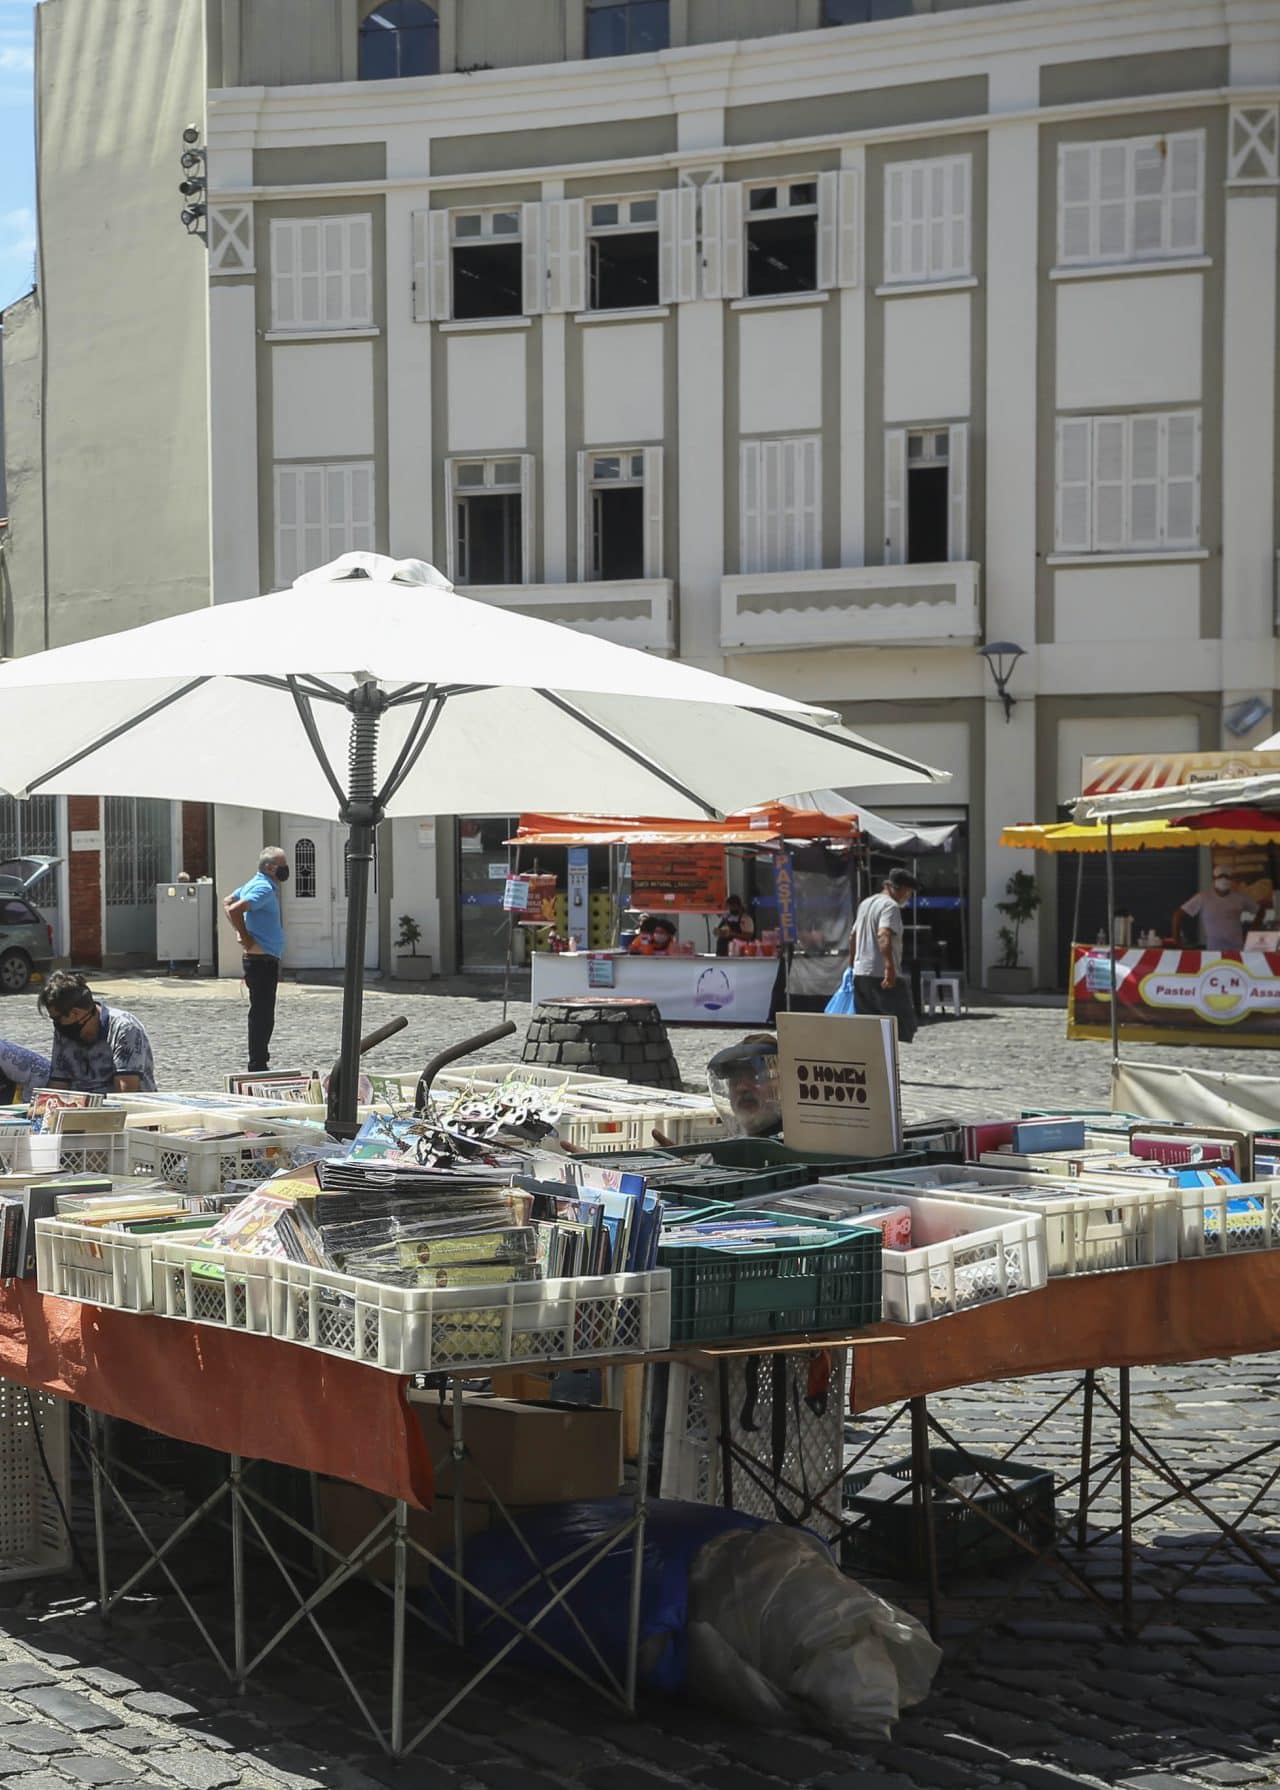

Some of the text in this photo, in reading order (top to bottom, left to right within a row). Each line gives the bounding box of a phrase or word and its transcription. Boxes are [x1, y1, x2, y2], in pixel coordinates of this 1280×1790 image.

[775, 855, 794, 942] PASTEL
[1156, 985, 1197, 997] Pastel
[797, 1065, 867, 1084] O HOMEM
[823, 1085, 867, 1103] POVO
